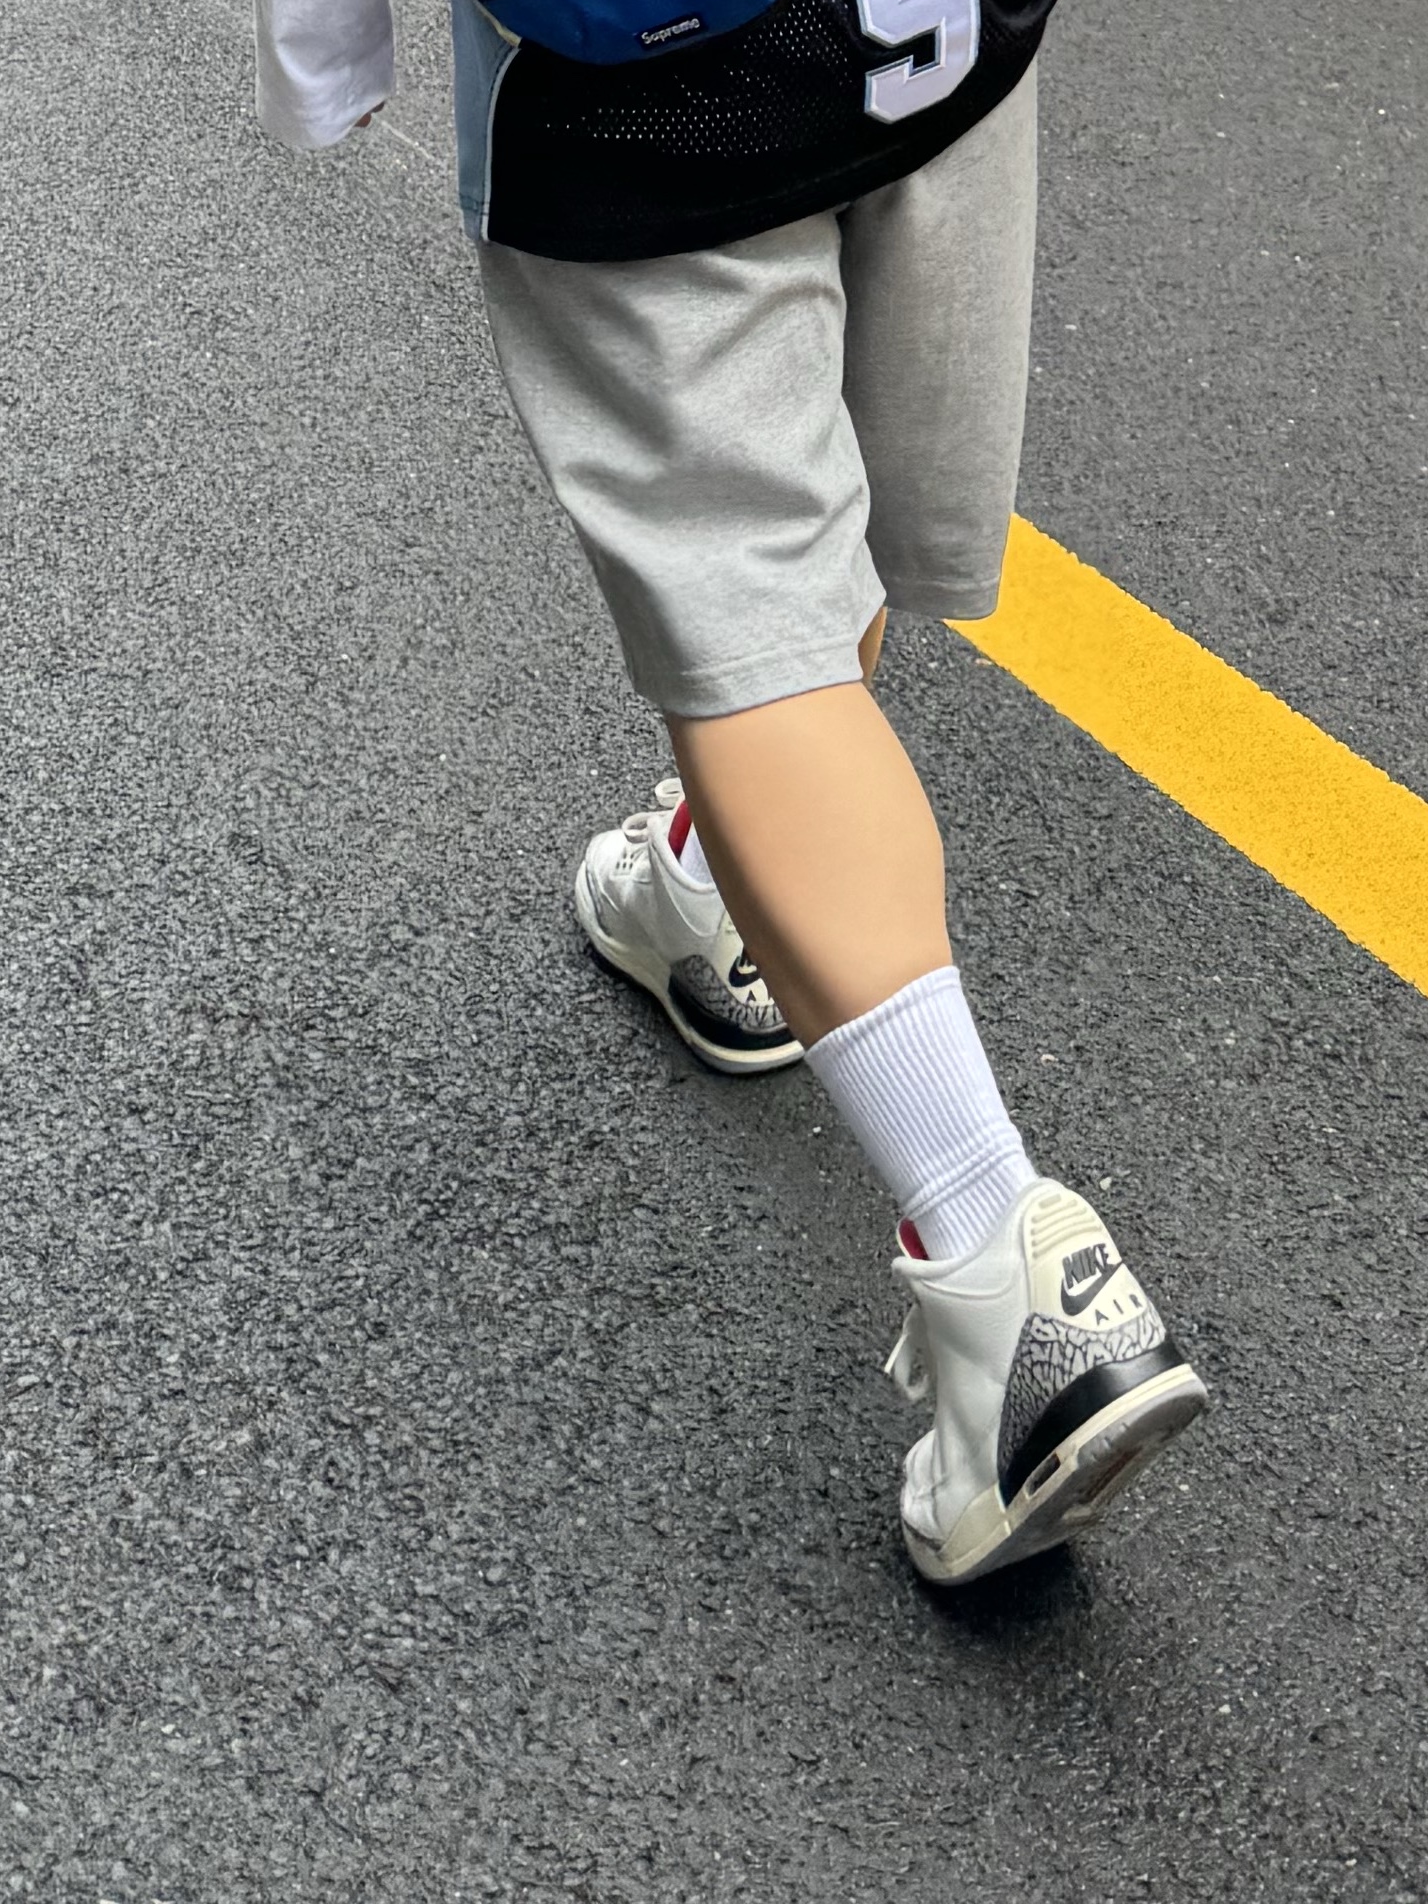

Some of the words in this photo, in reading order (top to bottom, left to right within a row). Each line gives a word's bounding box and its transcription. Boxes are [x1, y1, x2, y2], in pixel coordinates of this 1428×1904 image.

[641, 18, 701, 44] Supreme
[1062, 1243, 1116, 1290] NIKE
[1094, 1293, 1143, 1326] AIR
